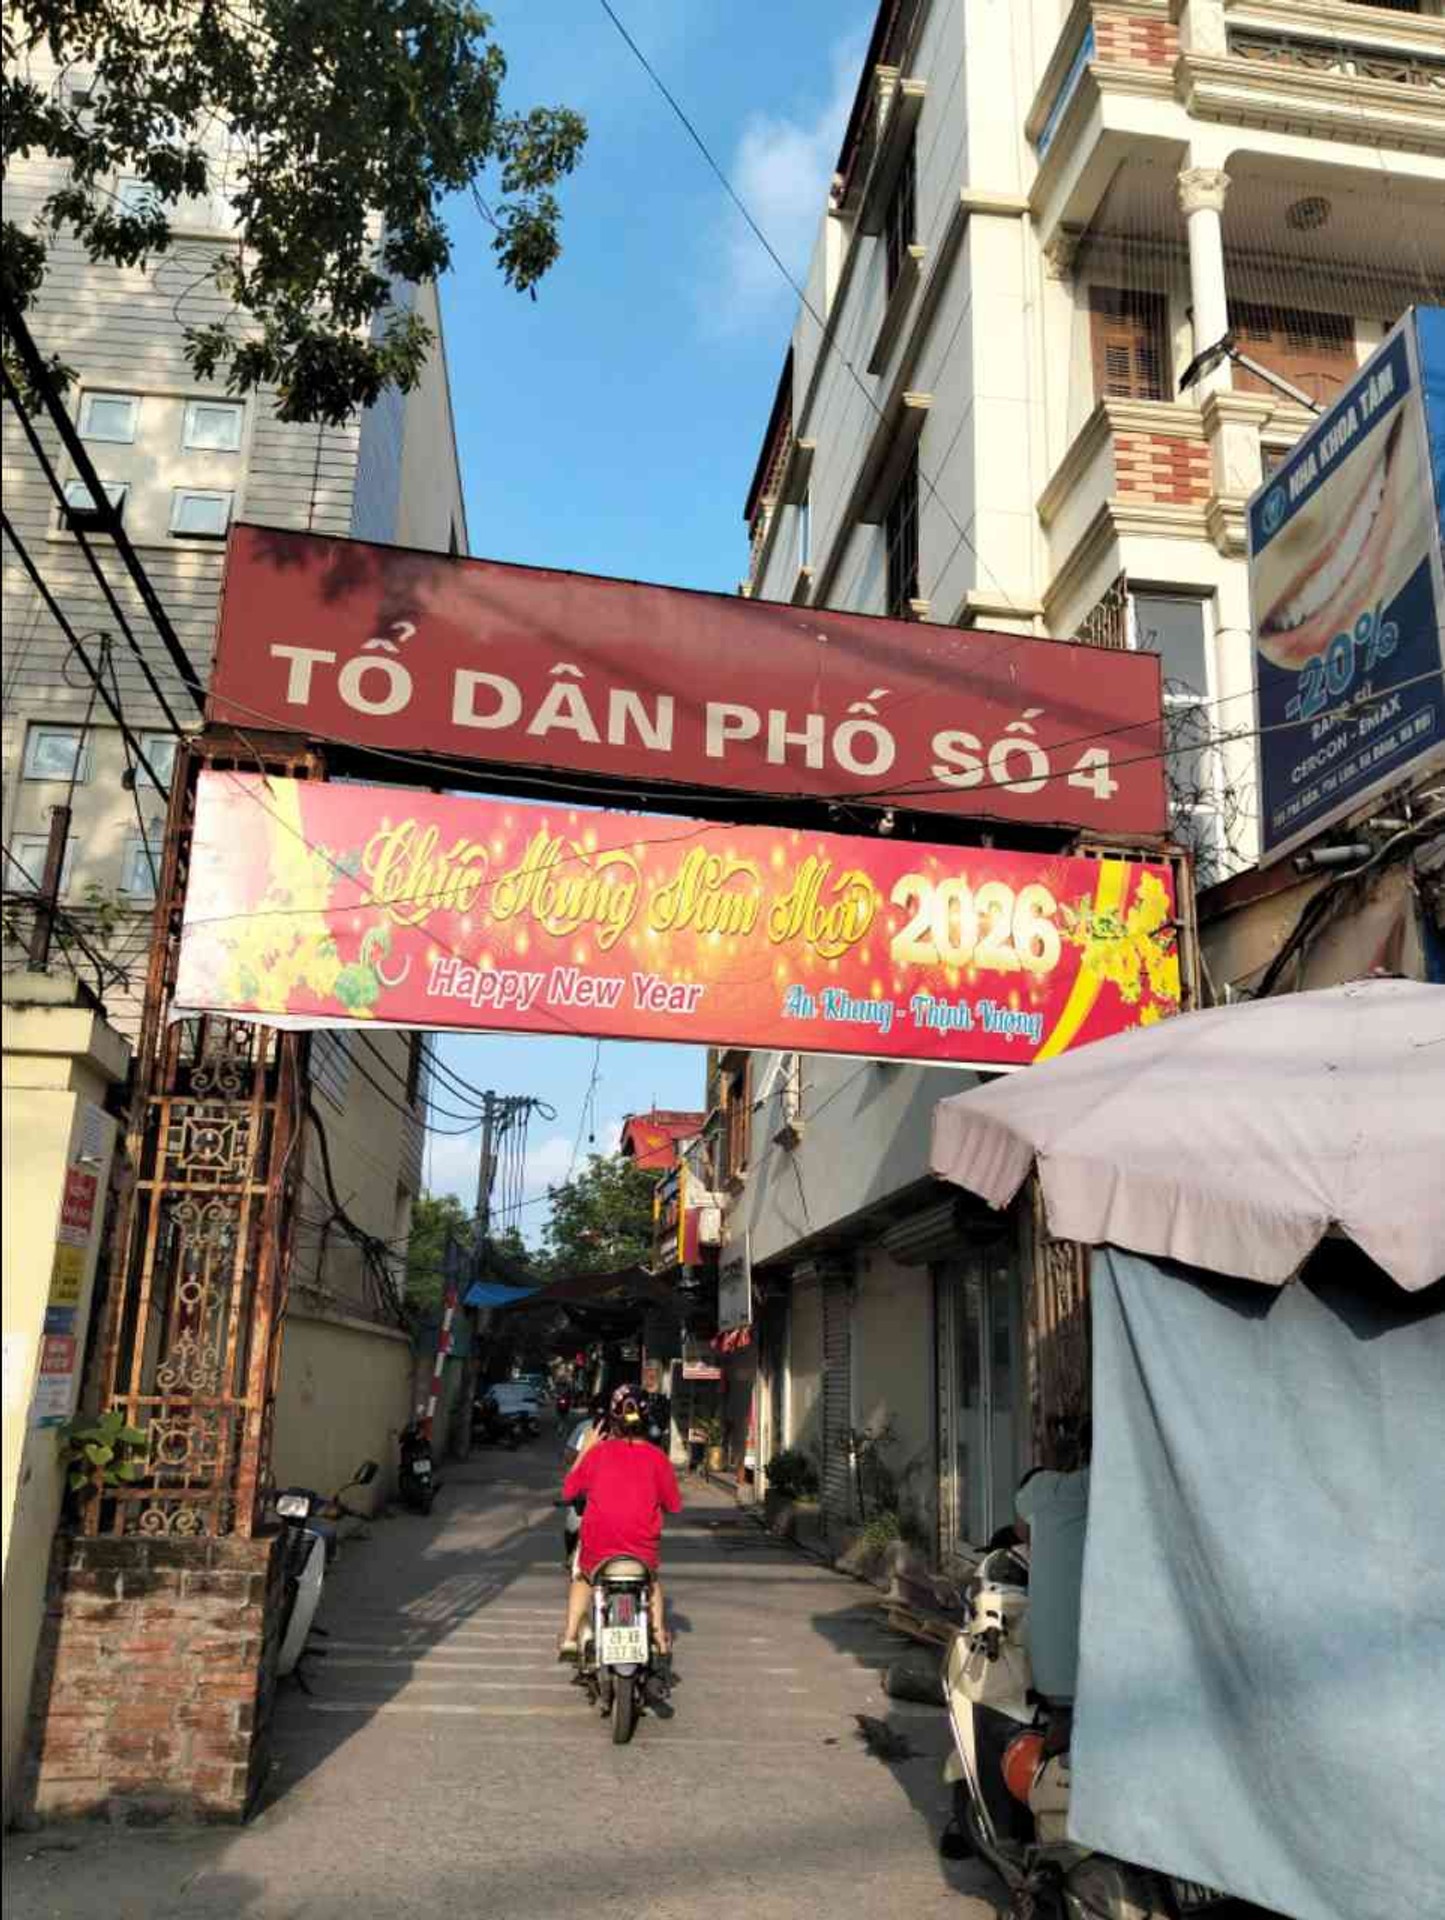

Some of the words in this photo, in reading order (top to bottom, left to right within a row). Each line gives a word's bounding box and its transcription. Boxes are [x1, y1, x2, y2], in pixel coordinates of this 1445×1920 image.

[1319, 407, 1359, 468] KHOA
[270, 621, 416, 716] TỔ
[452, 662, 674, 752] DÂN
[706, 688, 896, 776] PHỐ
[931, 708, 1050, 794] SỐ
[1067, 747, 1119, 799] 4
[361, 818, 488, 926] Chúc
[491, 830, 642, 952] Mừng
[649, 845, 764, 936] Năm
[768, 854, 880, 959] Mới
[890, 873, 1062, 974] 2026
[427, 957, 544, 1011] Happy
[547, 966, 624, 1009] New
[630, 971, 703, 1018] Year
[782, 984, 819, 1019] An
[822, 986, 896, 1033] Khang
[909, 993, 975, 1036] Thịnh
[976, 998, 1043, 1045] Vượng
